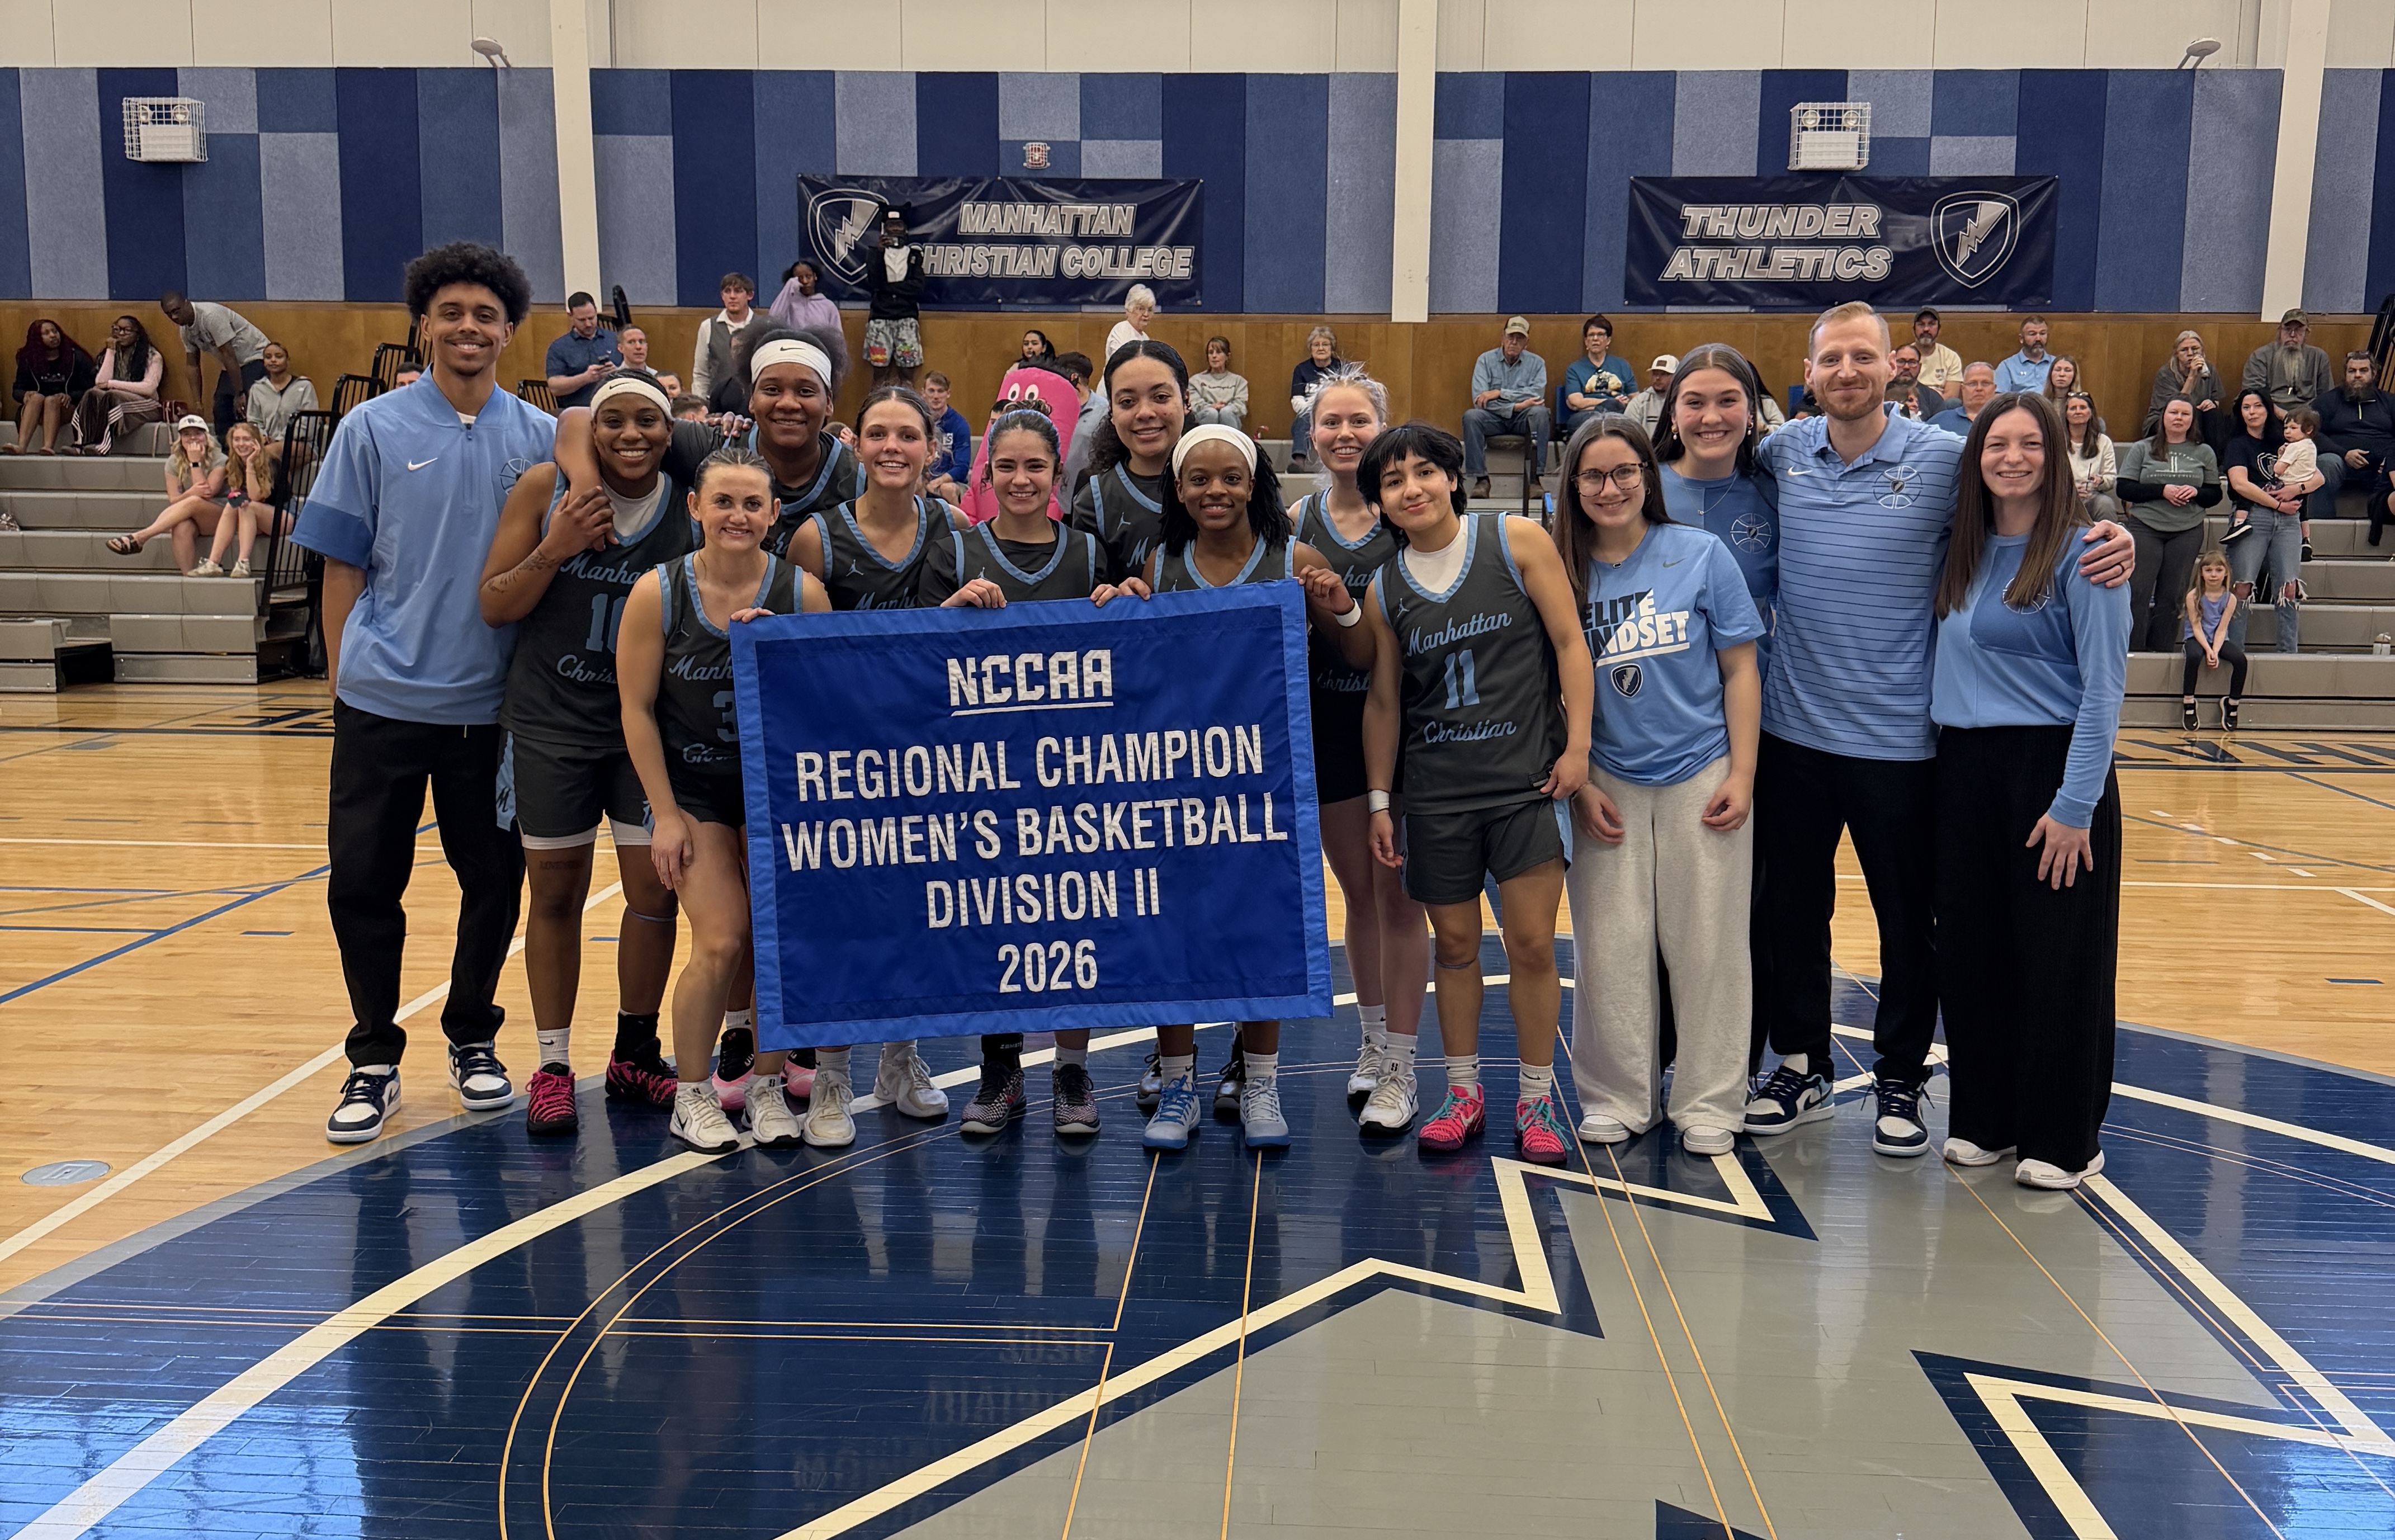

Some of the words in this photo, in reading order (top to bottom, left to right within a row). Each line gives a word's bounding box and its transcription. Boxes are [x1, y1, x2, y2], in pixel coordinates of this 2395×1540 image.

[957, 202, 1137, 237] MANHATTAN
[1680, 204, 1881, 238] THUNDER
[908, 242, 1059, 278] HRISTIAN
[1060, 244, 1194, 279] COLLEGE
[1659, 246, 1893, 281] ATHLETICS
[1407, 613, 1512, 657] Manhattan
[947, 649, 1113, 706] NCCAA
[1444, 649, 1480, 710] 11
[1424, 719, 1517, 743] Christian
[795, 740, 1021, 802] REGIONAL
[1036, 724, 1263, 787] CHAMPION
[782, 809, 1001, 872] WOMEN'S
[1016, 791, 1288, 857] BASKETBALL
[927, 870, 1118, 929] DIVISION
[1135, 867, 1160, 917] II
[998, 939, 1098, 993] 2026
